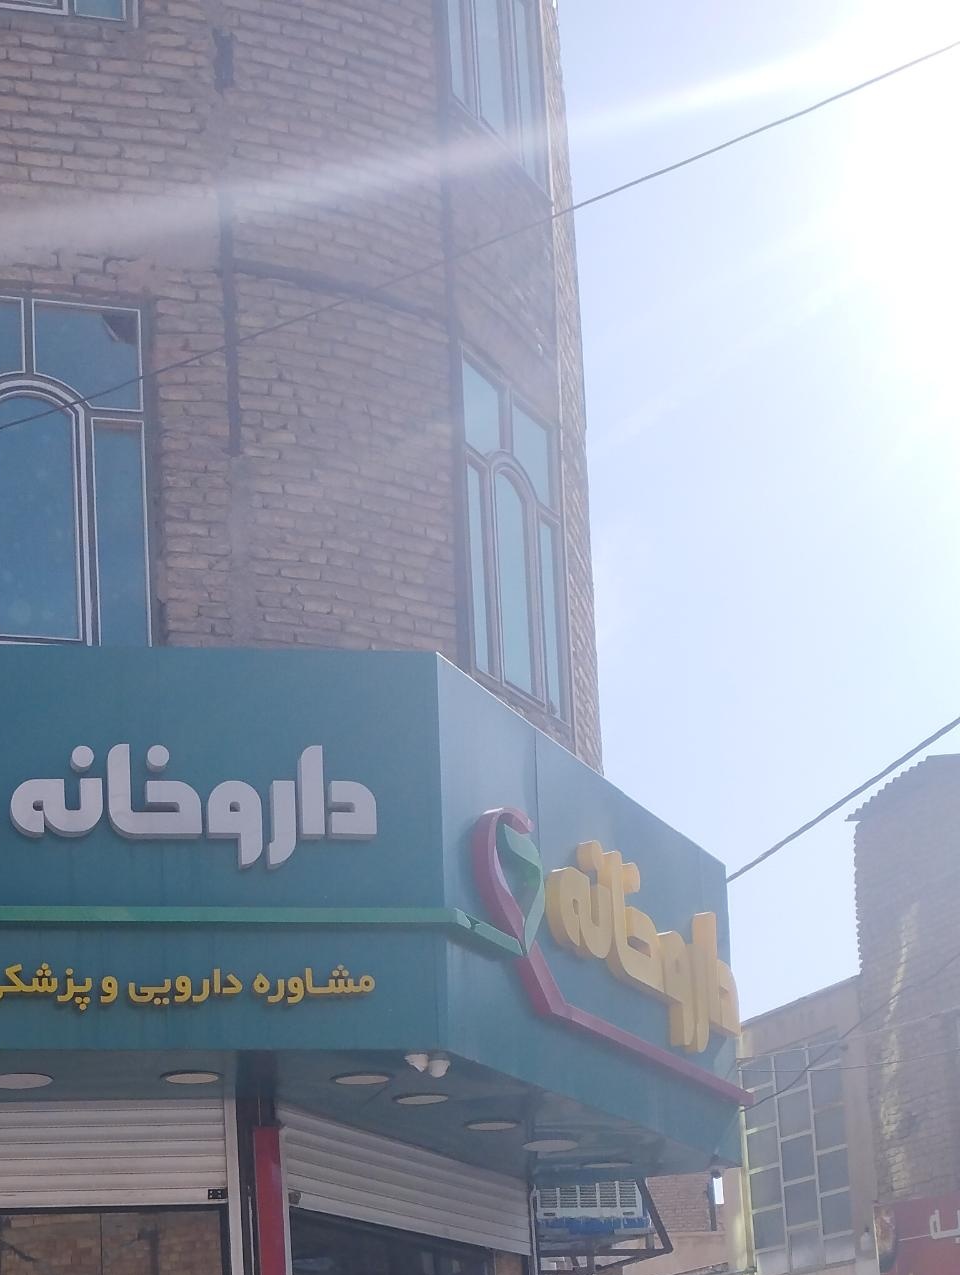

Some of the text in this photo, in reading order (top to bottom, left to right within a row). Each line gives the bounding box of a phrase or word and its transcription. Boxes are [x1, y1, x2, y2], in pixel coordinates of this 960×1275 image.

[9, 743, 377, 870] داروخانه
[100, 976, 118, 1002] و
[128, 968, 243, 1005] دارویی
[253, 964, 376, 1003] مشاوره
